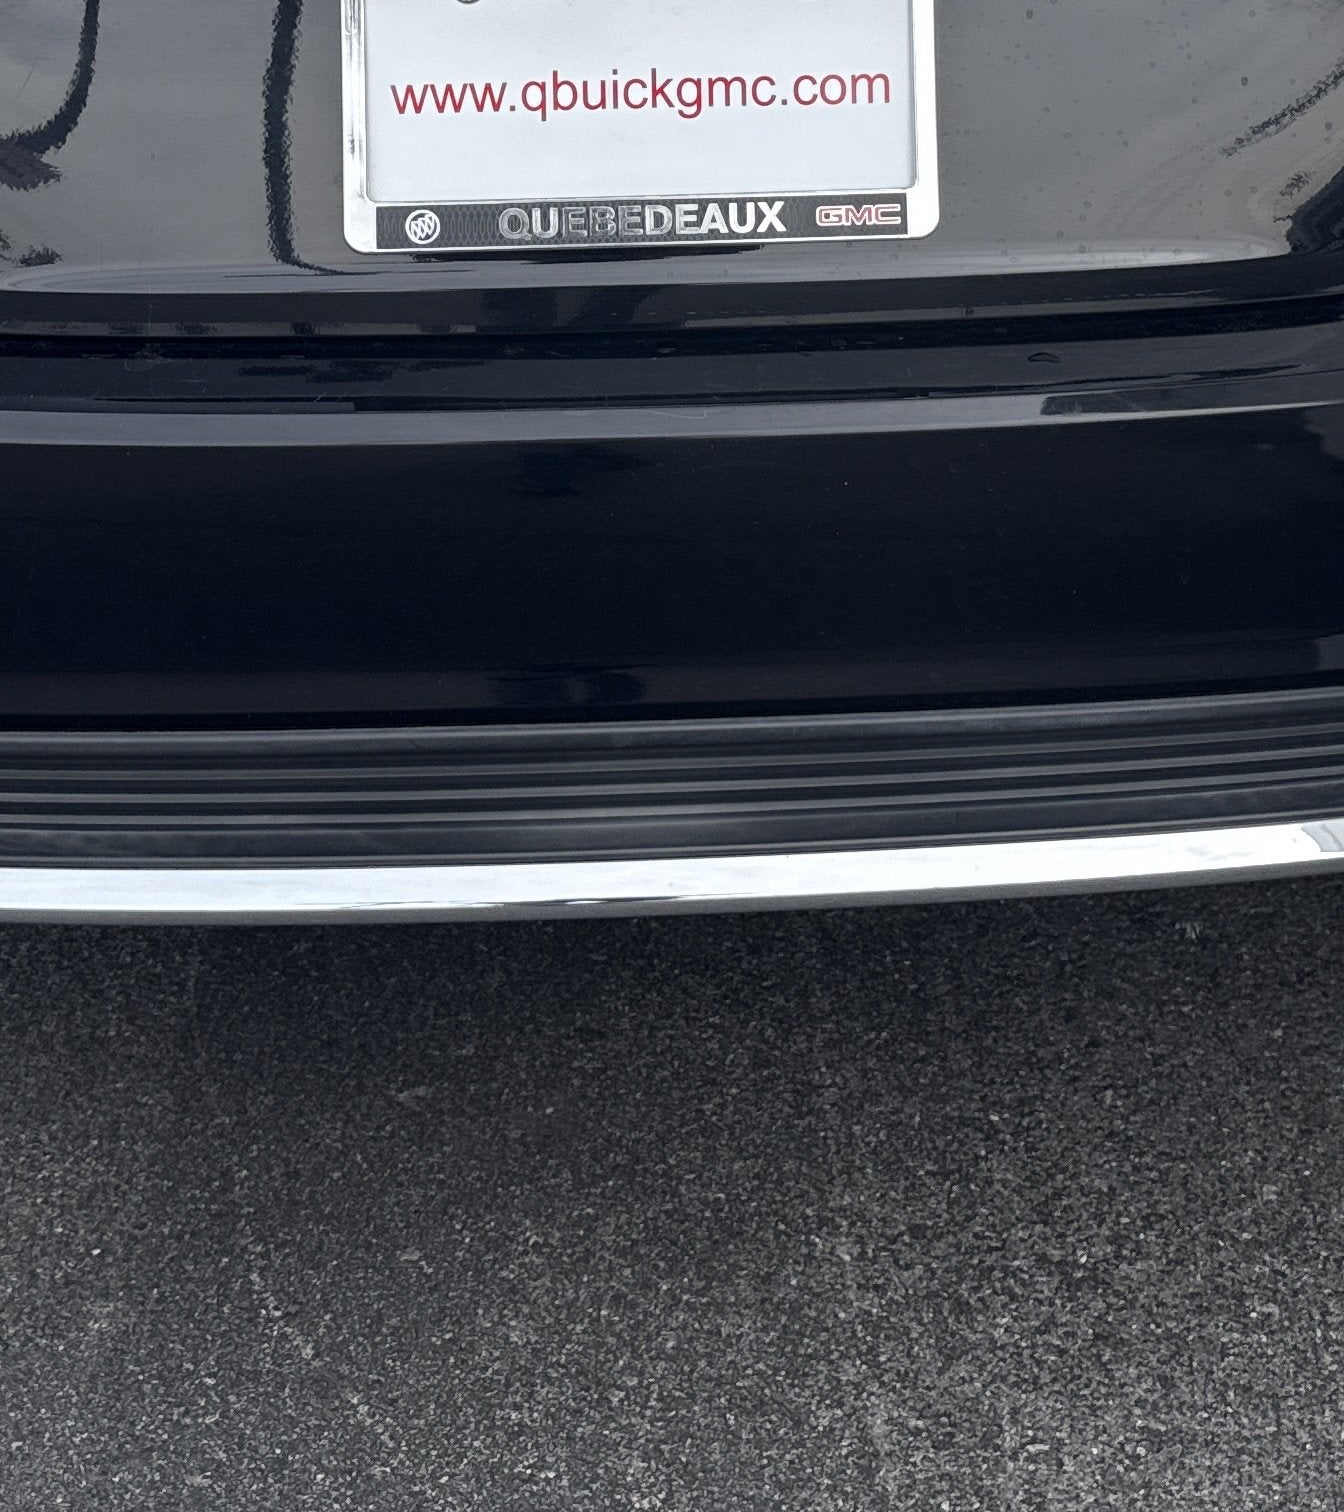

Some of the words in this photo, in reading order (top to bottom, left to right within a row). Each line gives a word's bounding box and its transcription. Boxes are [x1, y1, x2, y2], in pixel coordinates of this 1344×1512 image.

[390, 67, 891, 122] www.qbuickgmc.com
[498, 200, 787, 241] QUEBEDEAUX
[815, 203, 902, 226] GMC
